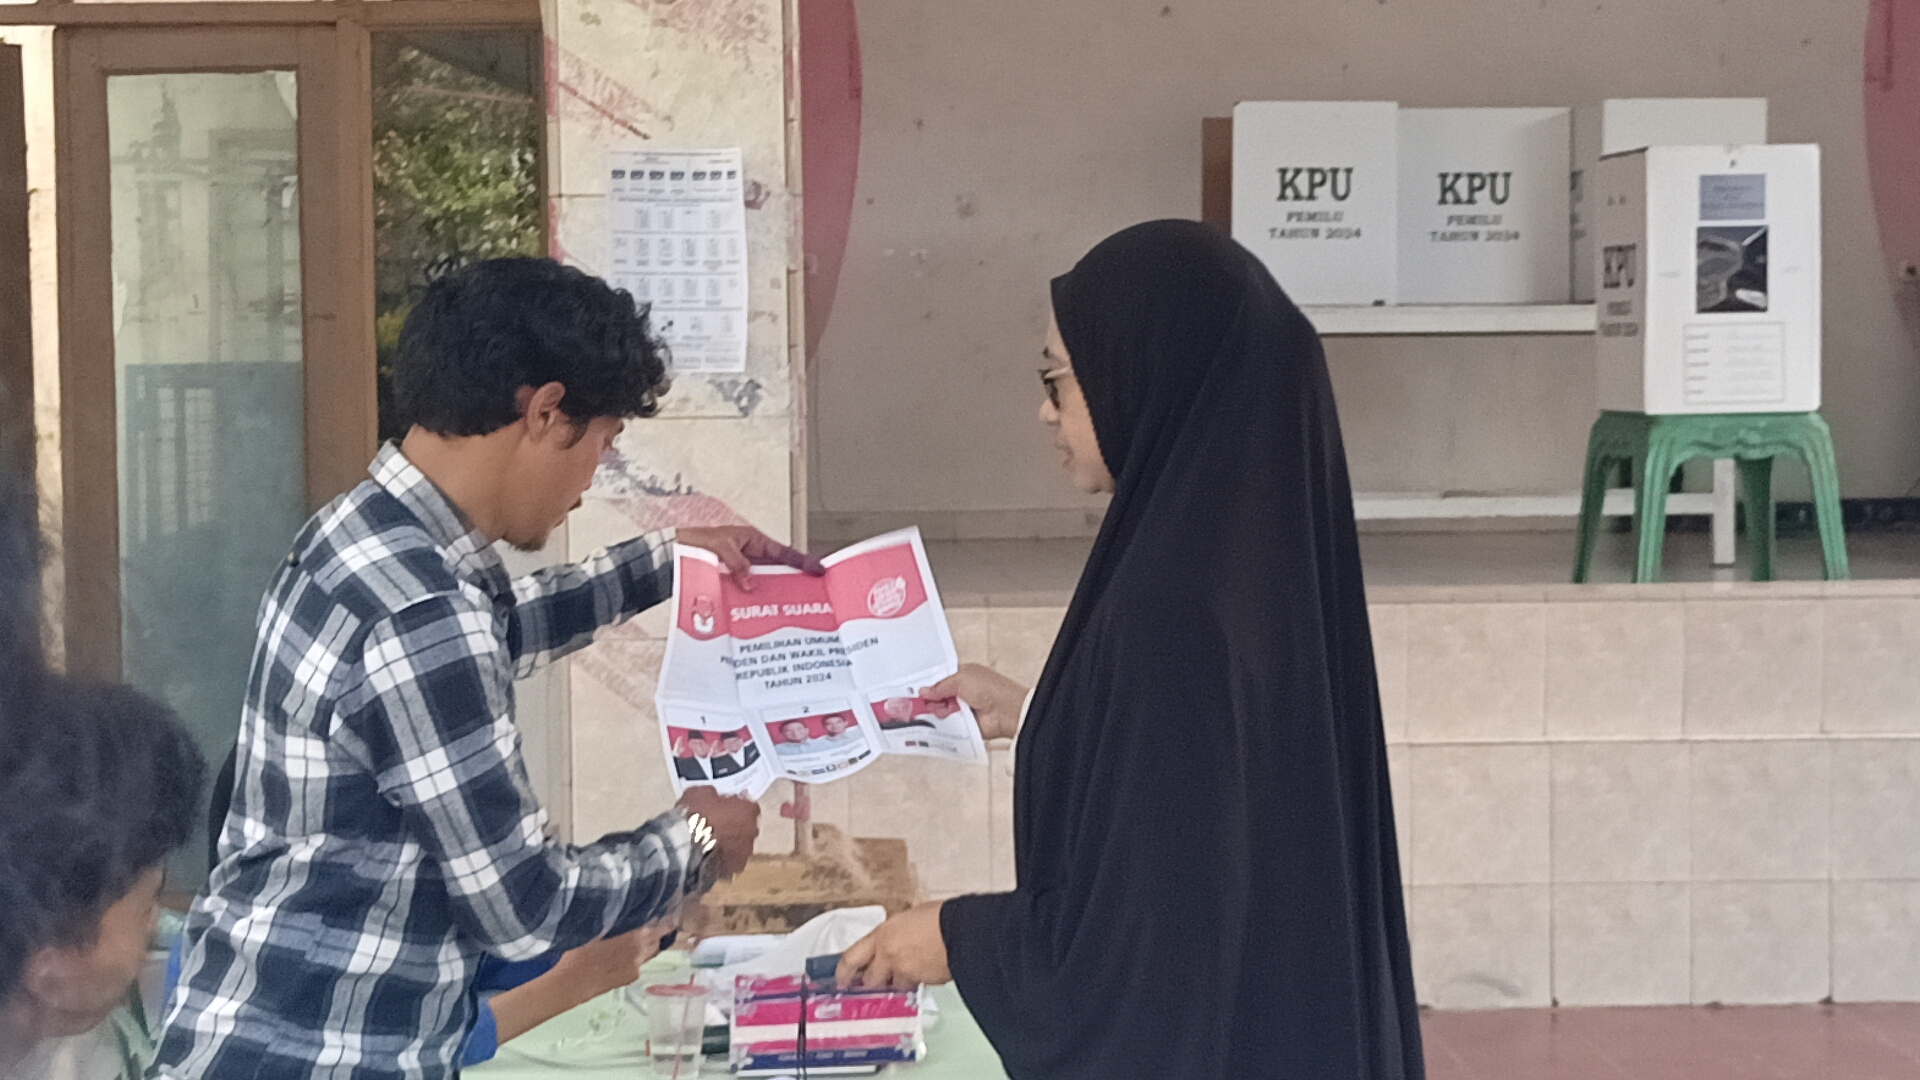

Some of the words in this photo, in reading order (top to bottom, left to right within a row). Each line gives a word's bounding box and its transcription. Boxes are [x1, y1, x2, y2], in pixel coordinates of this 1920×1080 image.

[1276, 167, 1354, 201] KPU
[1437, 171, 1512, 205] KPU
[1286, 211, 1344, 223] PEMILU
[1446, 215, 1503, 226] PEMILU
[1268, 227, 1320, 240] TAHUN
[1430, 231, 1479, 242] TAHUN
[730, 604, 779, 621] SURAT
[782, 603, 832, 616] SUARA
[740, 638, 801, 653] PEMILIHAN
[805, 636, 840, 645] UMUM
[761, 652, 786, 664] DAN
[790, 648, 825, 659] WAKIL
[829, 637, 879, 655] PRESIDEN
[735, 666, 788, 680] REPUBLIK
[793, 659, 853, 672] INDONESIA
[765, 677, 802, 689] TAHUN
[807, 672, 832, 683] 2024
[801, 705, 809, 714] 2
